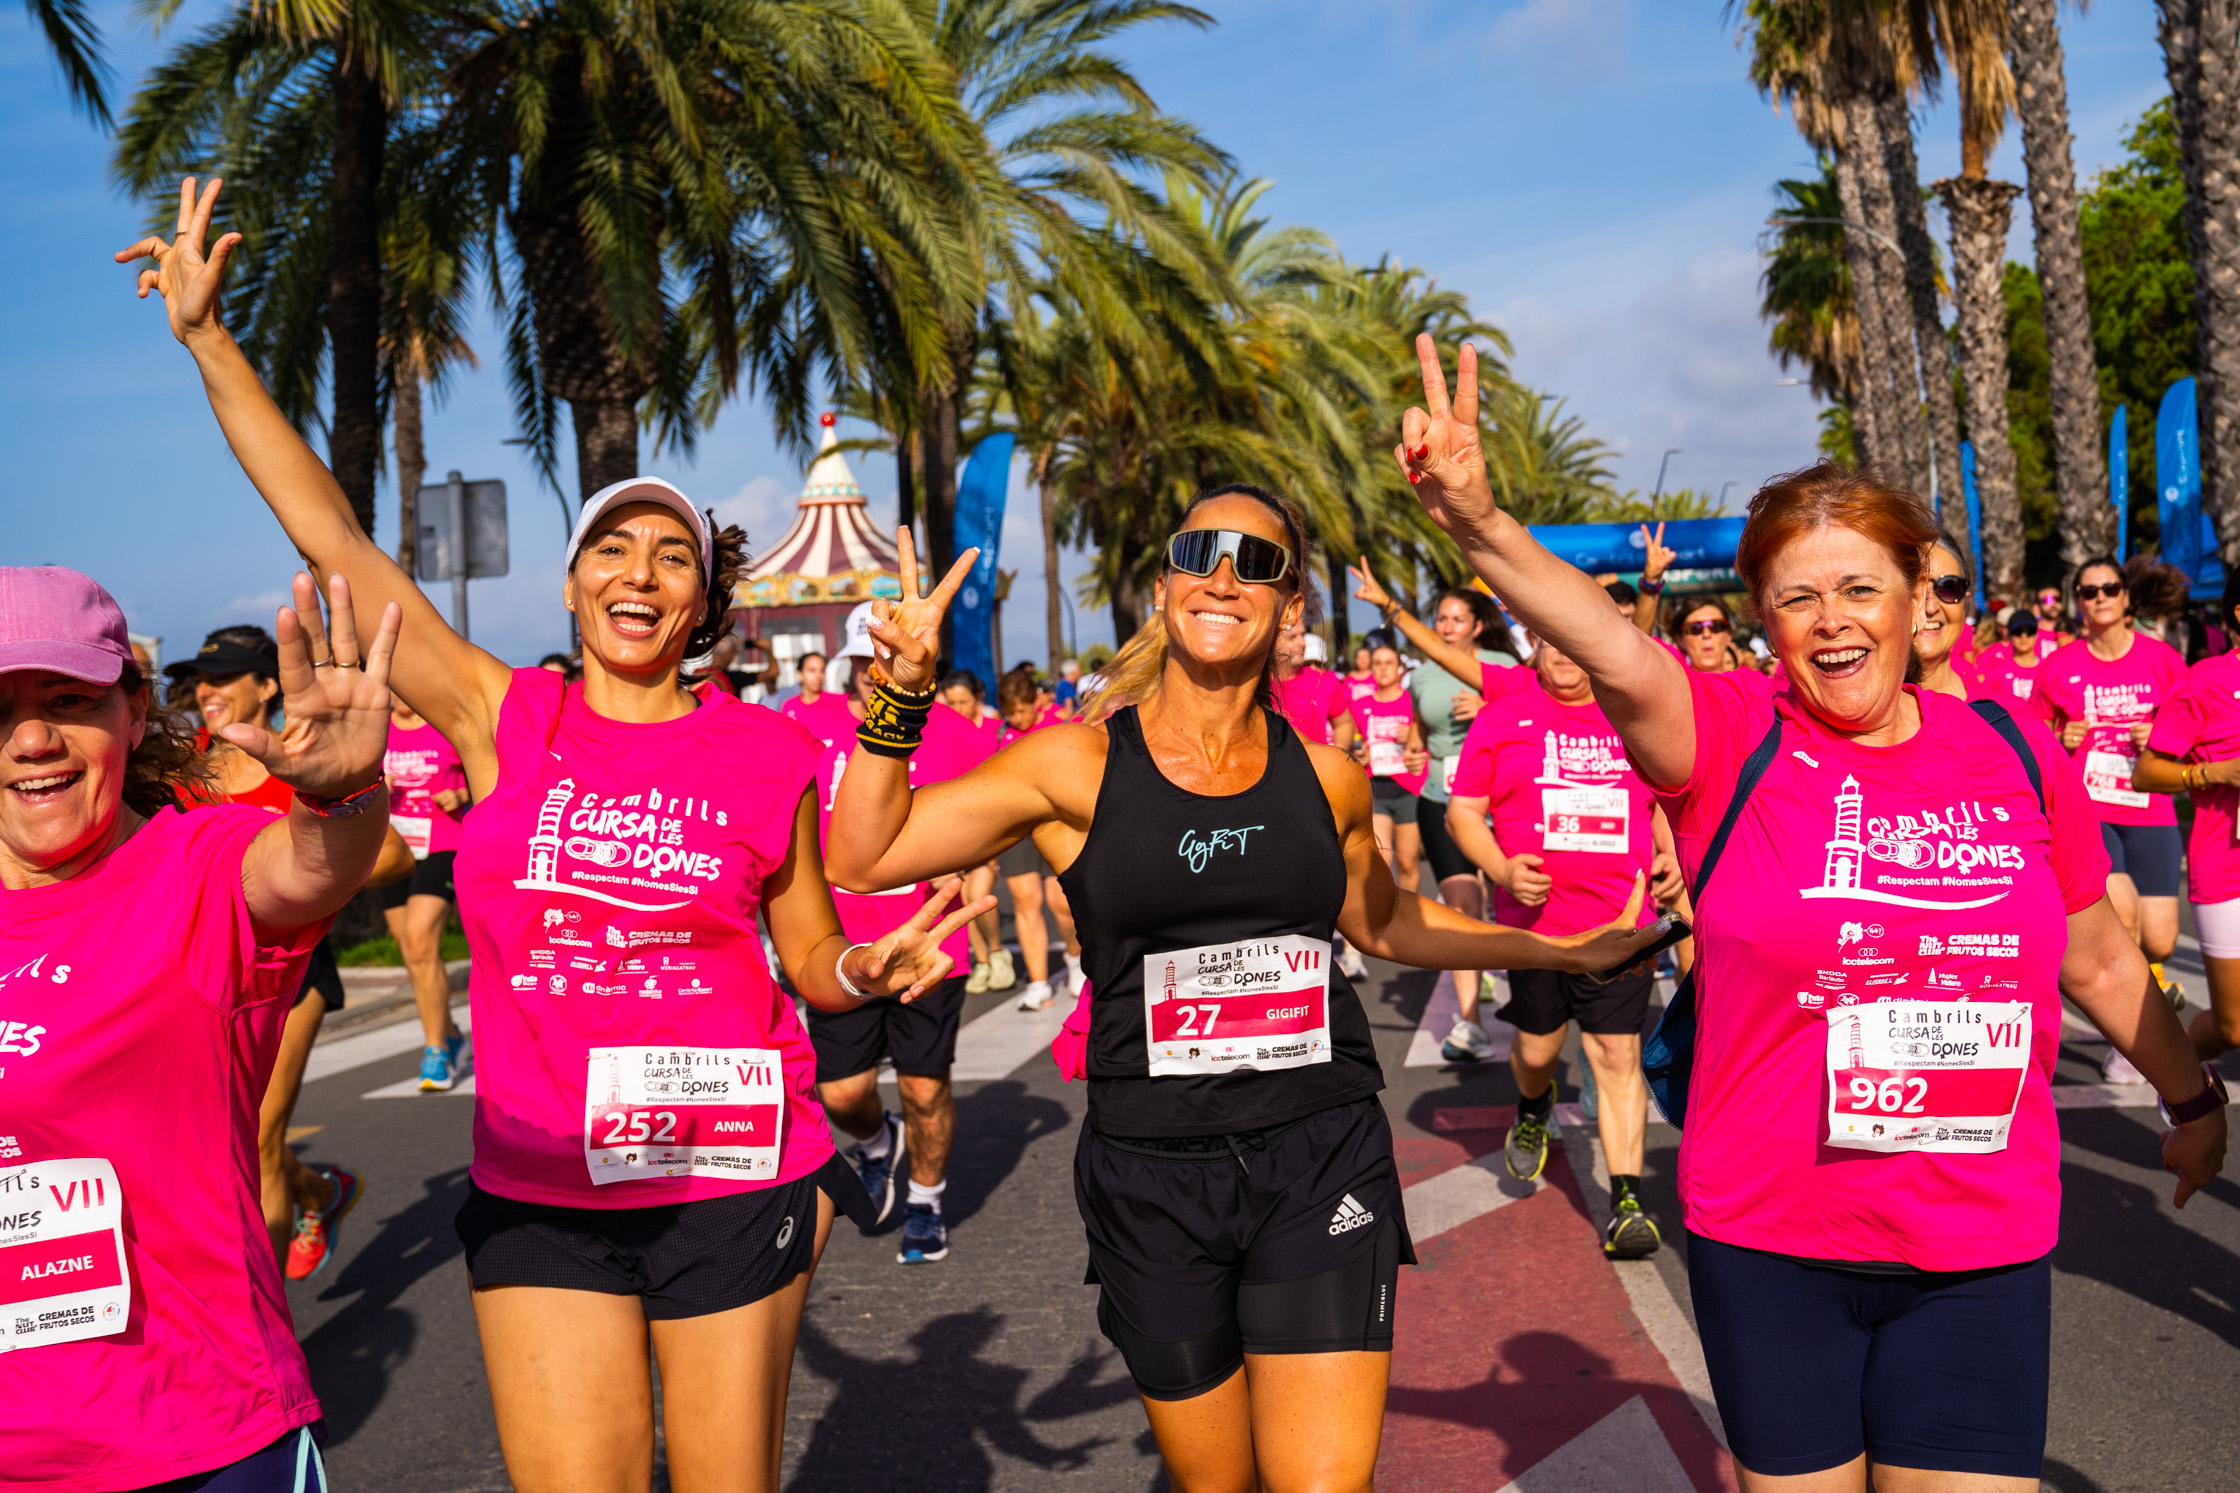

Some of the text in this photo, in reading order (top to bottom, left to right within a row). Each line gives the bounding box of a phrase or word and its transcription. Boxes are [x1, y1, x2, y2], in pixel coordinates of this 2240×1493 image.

[1559, 733, 1623, 747] Cambril
[581, 788, 728, 826] Cambrils
[570, 809, 658, 843] CURSA
[660, 817, 683, 833] DE
[1557, 815, 1580, 833] 36
[658, 831, 684, 846] LES
[1956, 827, 1979, 841] LES
[633, 843, 723, 881] DONES
[1937, 840, 2025, 875] DONES
[572, 871, 630, 885] #Respectam
[1877, 875, 1940, 887] #Respectam
[1948, 934, 2020, 946] CREMAS DE
[1199, 944, 1279, 964] Cambrils
[1946, 946, 2019, 957] FRUTOS SECOS
[1198, 962, 1232, 974] CURSA
[1284, 950, 1320, 973] VII
[1234, 971, 1281, 987] DONES
[1201, 988, 1239, 996] #Respectam
[1175, 1004, 1310, 1036] 27 GIGIFIT
[1888, 1009, 1982, 1024] Cambrils
[1888, 1026, 1930, 1040] CURSA
[1931, 1033, 1944, 1041] LES
[1986, 1023, 2021, 1047] VII
[1272, 1045, 1299, 1053] CREMAS
[1931, 1042, 1980, 1060] DONES
[645, 1053, 731, 1066] Cambrils
[644, 1067, 680, 1079] CURSA
[736, 1065, 772, 1086] VII
[681, 1081, 729, 1096] DONES
[1850, 1076, 1928, 1113] 962
[603, 1111, 754, 1144] 252 ANNA
[49, 1177, 105, 1213] VII
[1329, 1211, 1374, 1235] adidas
[21, 1255, 94, 1281] ALAZNE
[38, 1305, 94, 1321] CREMAS DE
[15, 1321, 34, 1329] NUT
[39, 1315, 95, 1330] FRUTOS SECOS
